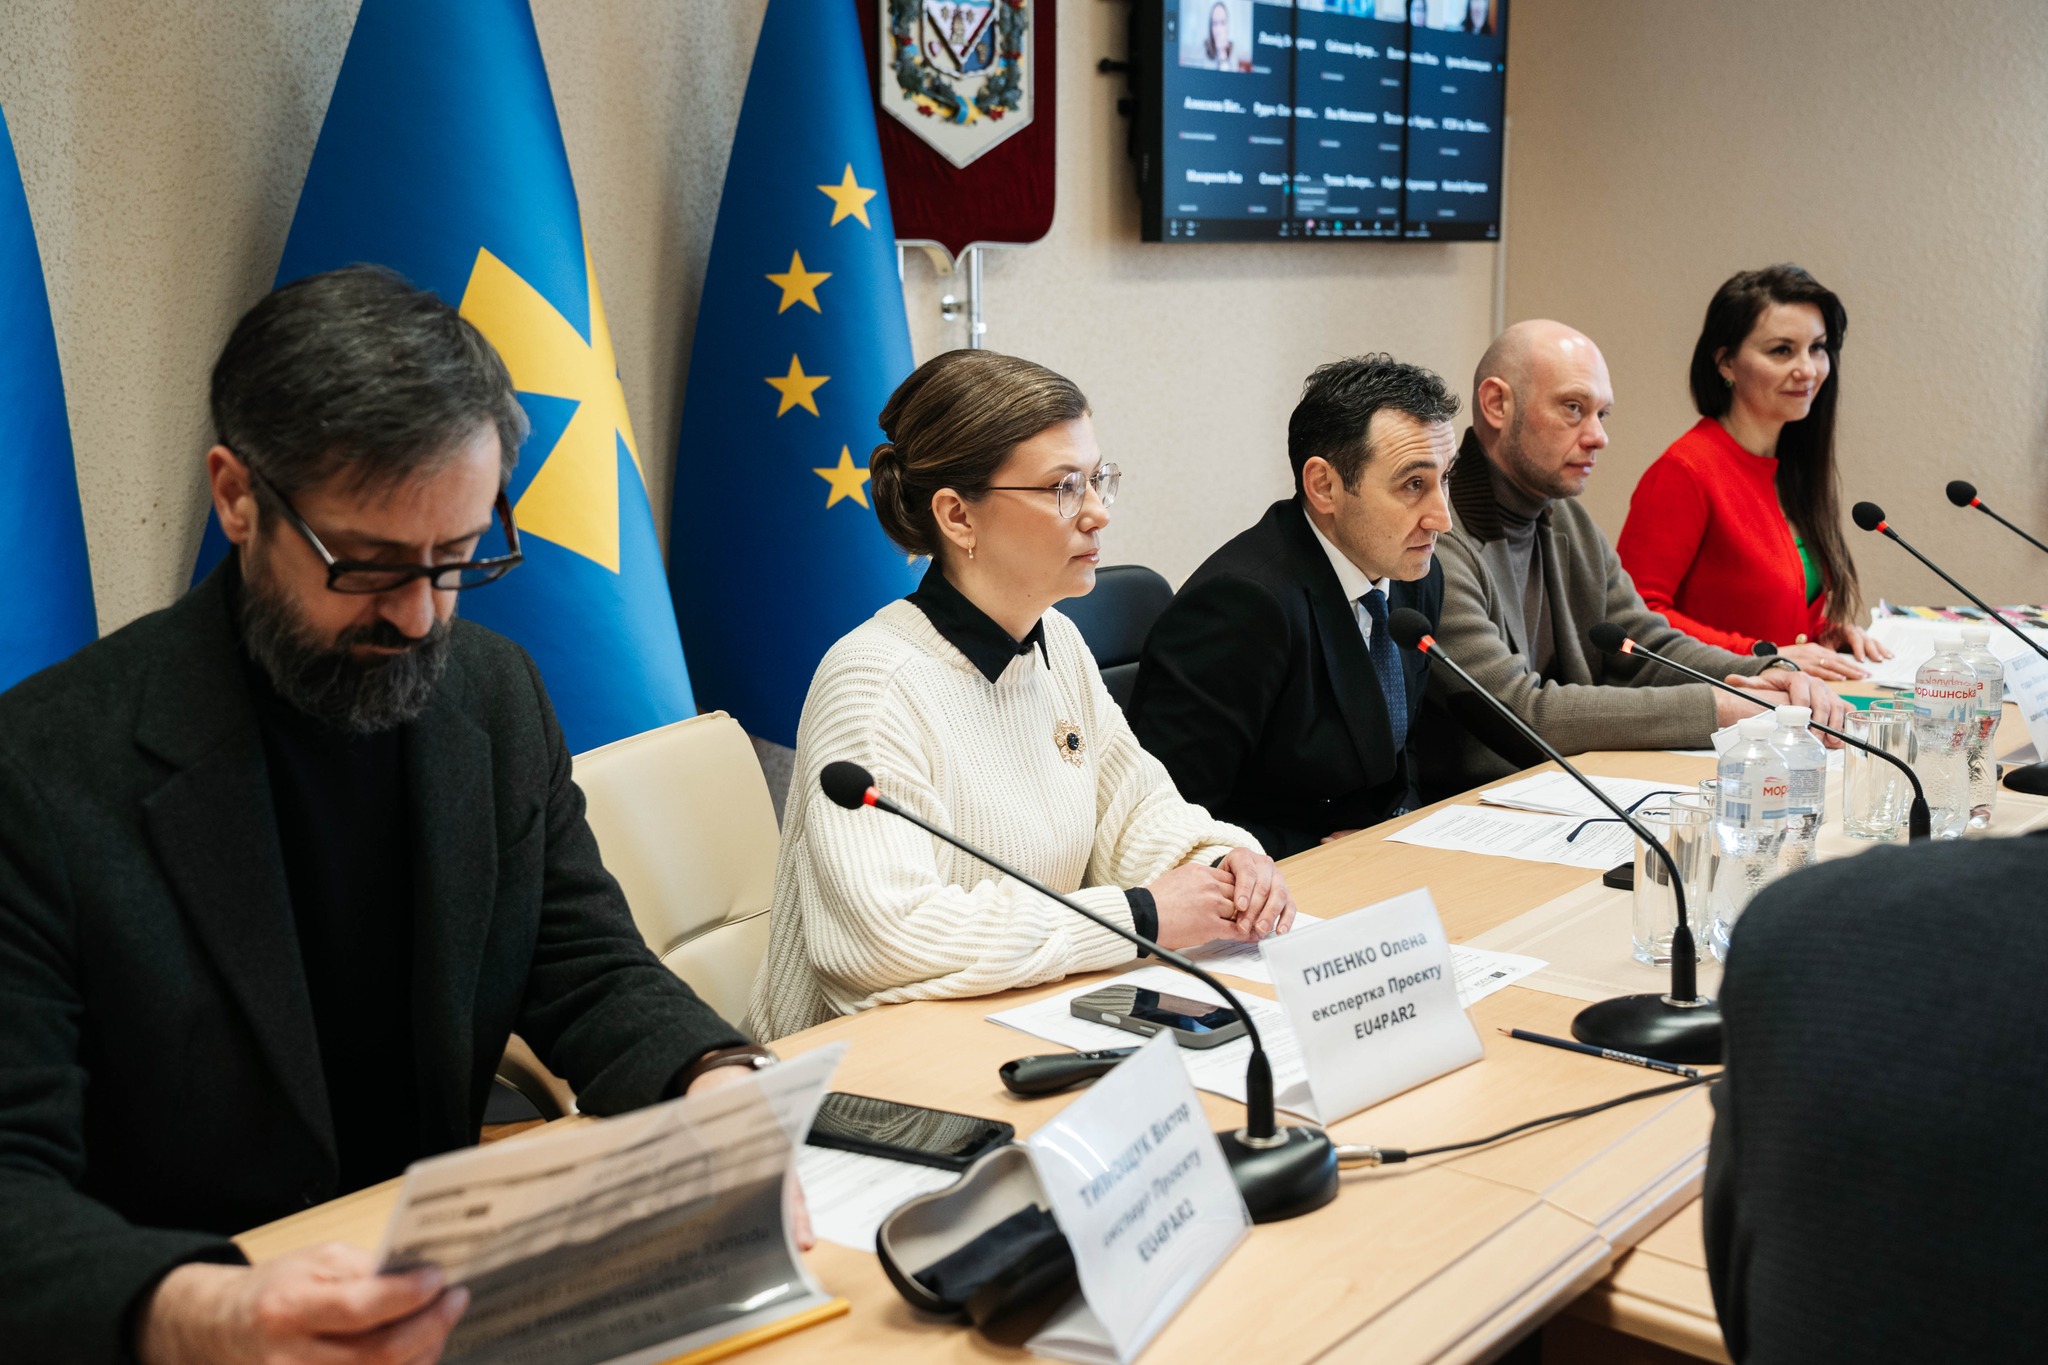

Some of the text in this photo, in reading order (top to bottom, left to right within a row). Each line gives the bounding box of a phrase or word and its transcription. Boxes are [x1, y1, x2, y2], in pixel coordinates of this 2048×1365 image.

[1763, 784, 1789, 798] мор
[1302, 946, 1377, 986] ГУЛЕНКО
[1380, 931, 1428, 958] Олена
[1311, 985, 1386, 1022] експертка
[1387, 963, 1442, 995] Проєкту
[1353, 1002, 1417, 1040] EU4PAR2
[1138, 1199, 1196, 1262] EU4PAR2
